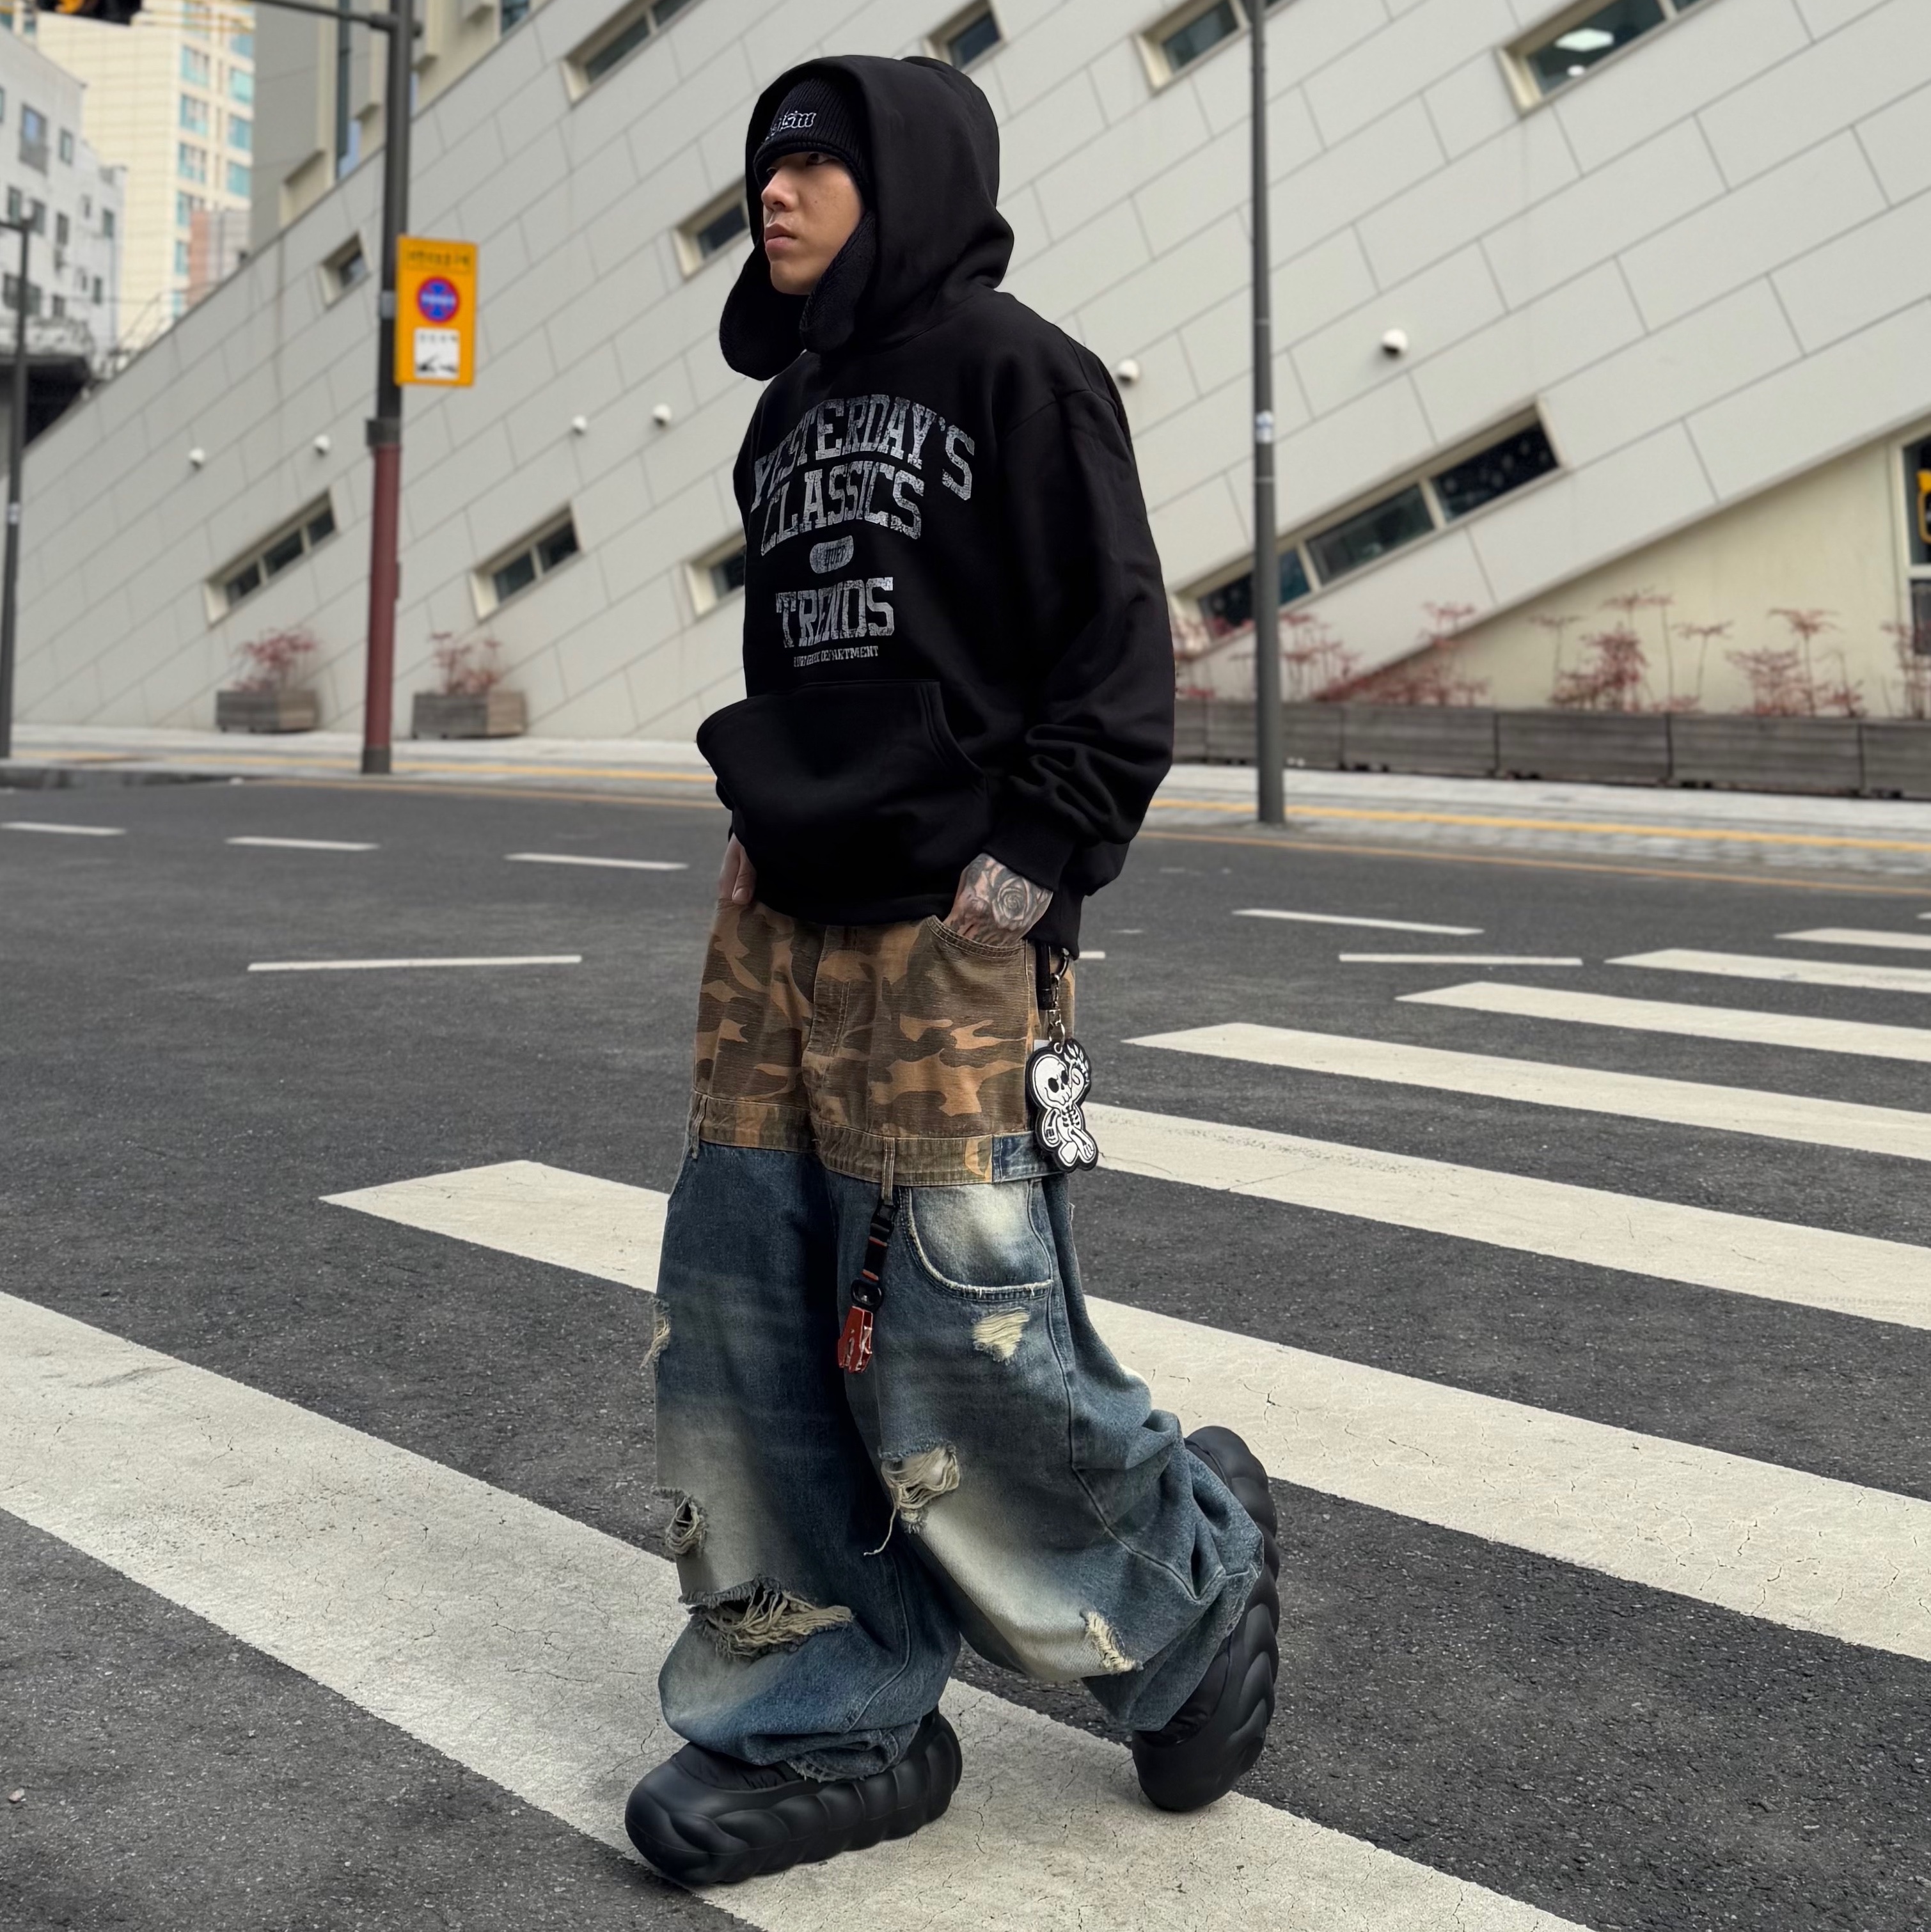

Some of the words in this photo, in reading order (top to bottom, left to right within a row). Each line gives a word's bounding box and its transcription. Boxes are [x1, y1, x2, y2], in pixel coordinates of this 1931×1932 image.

[751, 394, 975, 512] YESTERDAY'S
[761, 460, 924, 556] CLASSICS
[776, 577, 895, 648] TRENDS
